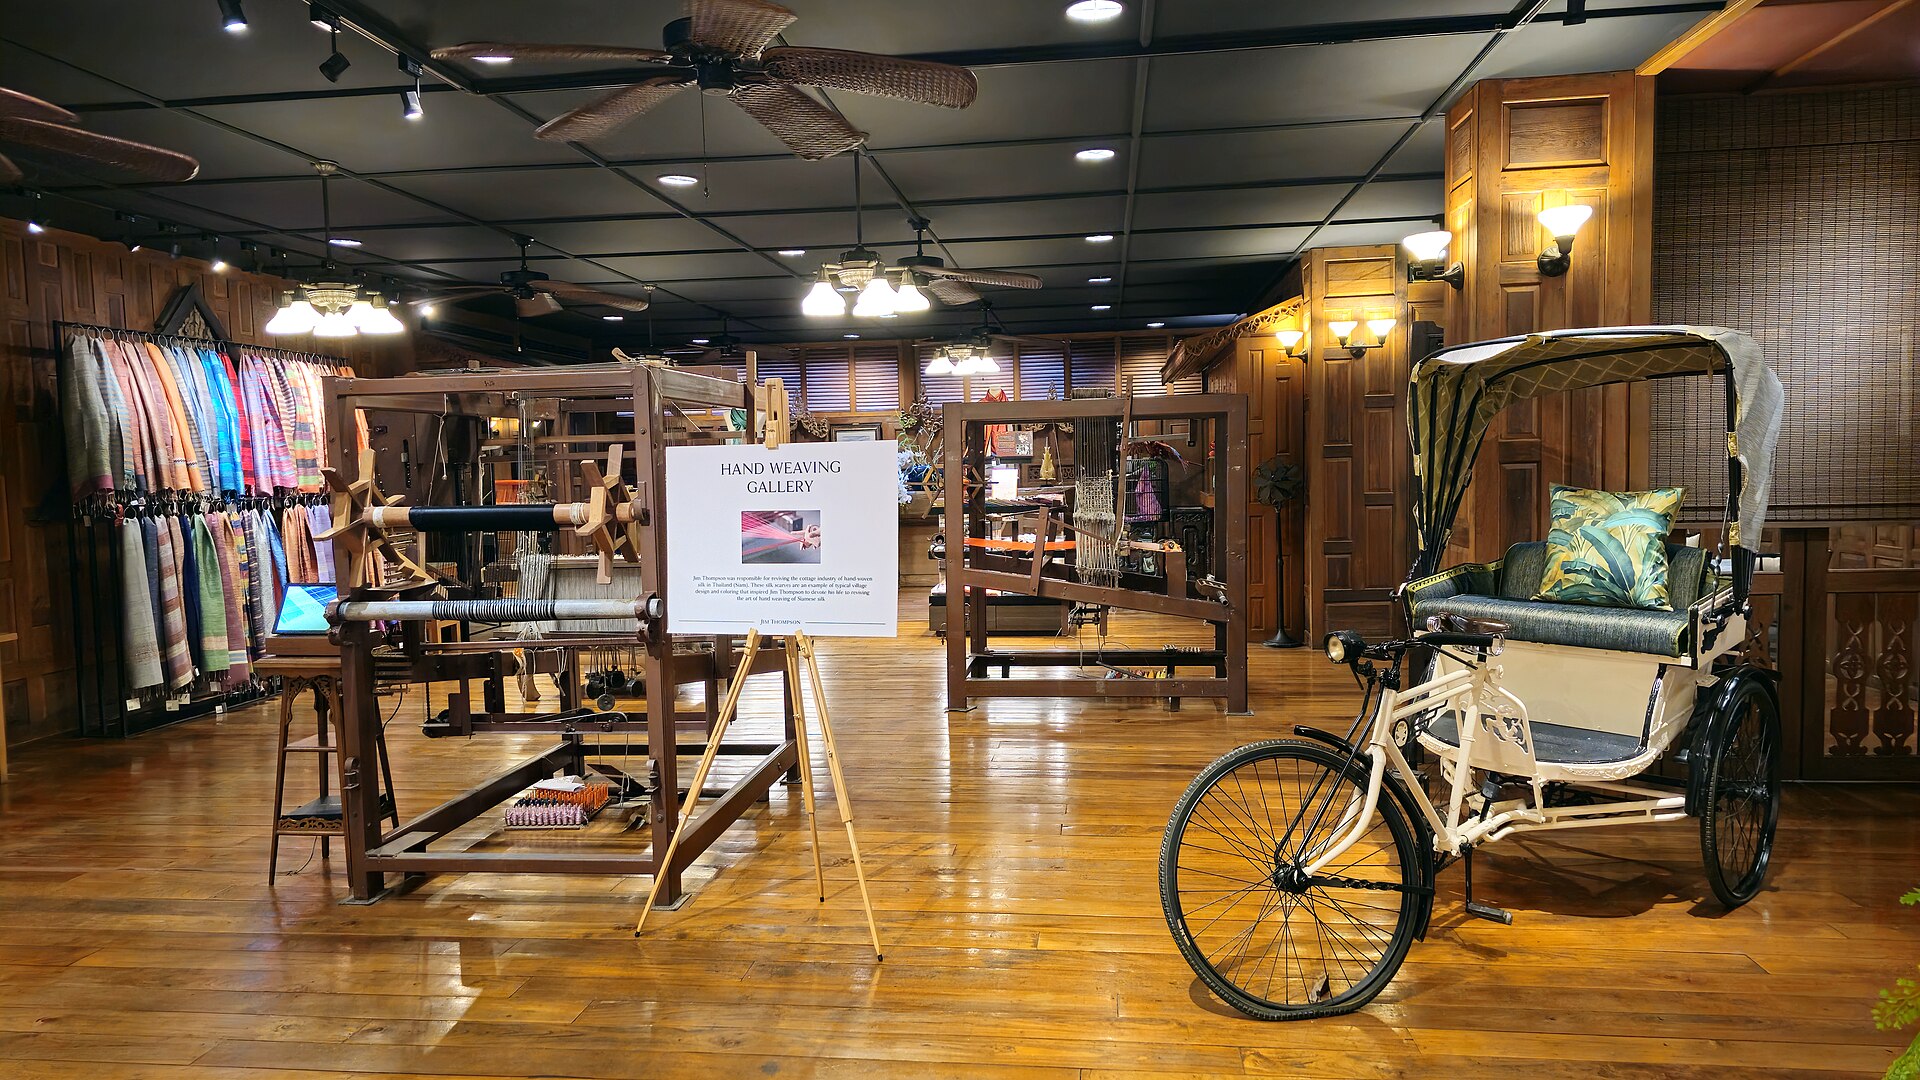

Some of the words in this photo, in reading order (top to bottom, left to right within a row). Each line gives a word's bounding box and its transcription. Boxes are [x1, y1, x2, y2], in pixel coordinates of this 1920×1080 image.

[721, 462, 765, 475] HAND
[770, 460, 841, 474] WEAVING
[747, 480, 814, 493] GALLERY
